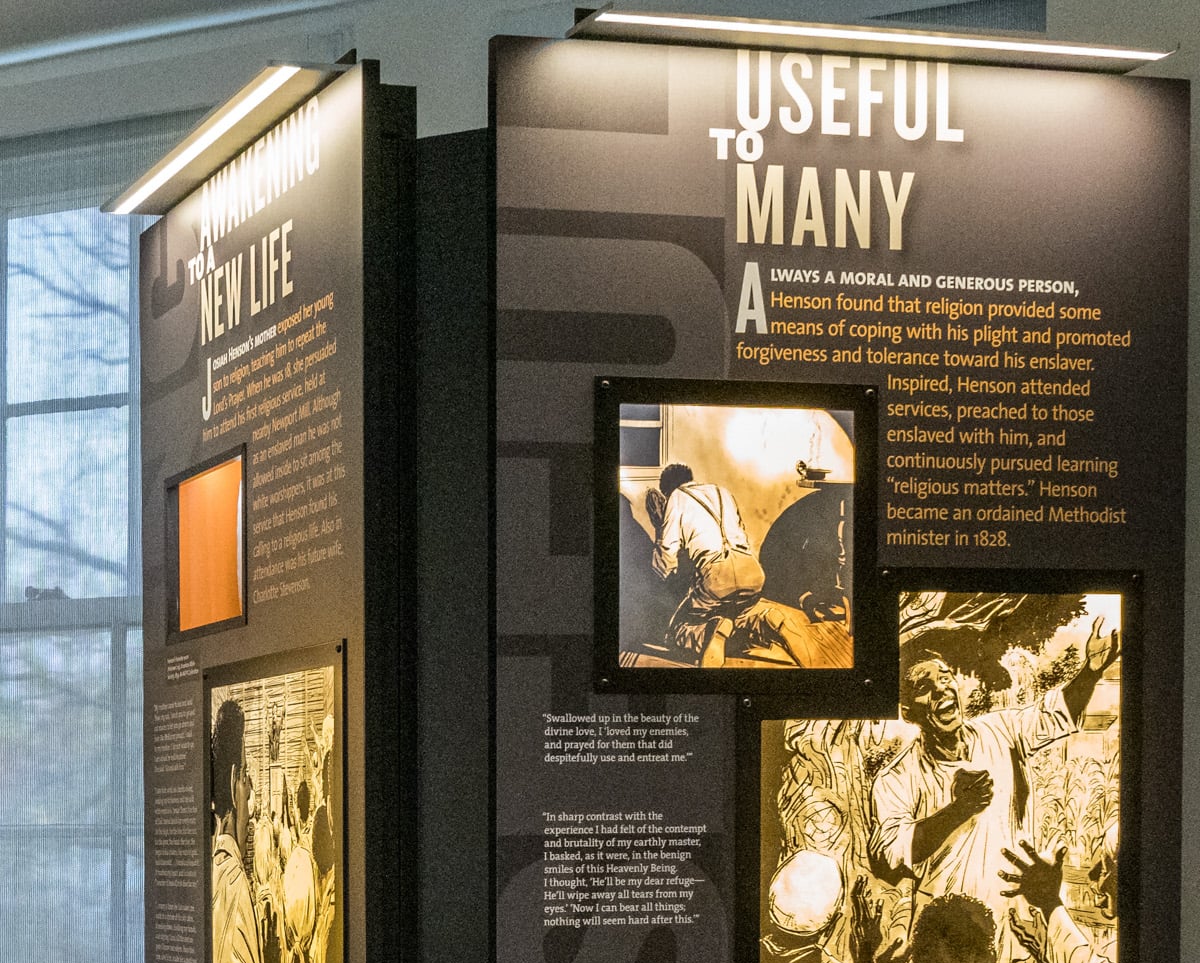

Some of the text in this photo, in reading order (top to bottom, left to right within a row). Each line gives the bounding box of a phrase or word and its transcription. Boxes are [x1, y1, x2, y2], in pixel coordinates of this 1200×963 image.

[736, 49, 964, 142] USEFUL
[709, 128, 763, 162] TO
[200, 95, 319, 252] AWAKENING
[736, 164, 915, 250] MANY
[188, 245, 216, 286] TO A
[201, 218, 294, 346] NEW LIFE
[824, 269, 836, 285] A
[840, 270, 894, 287] MORAL
[898, 272, 932, 289] AND
[935, 274, 1014, 292] GENEROUS
[1018, 277, 1080, 297] PERSON,
[770, 292, 1102, 322] Henson found that religion provided some
[770, 319, 1131, 350] means of coping with his plight and promoted
[736, 342, 1094, 371] forgiveness and tolerance toward his enslaver.
[887, 374, 1090, 397] Inspired, Henson attended
[886, 400, 1094, 424] services, preached to those
[886, 426, 1066, 449] enslaved with him, and
[886, 452, 1118, 479] continuously pursued learning
[1039, 480, 1097, 498] Henson
[886, 502, 1126, 524] became an ordained Methodist
[886, 528, 1010, 548] minister in 1828.
[544, 726, 574, 737] divine
[576, 726, 596, 738] love,
[598, 726, 602, 737] I
[632, 729, 647, 739] my
[649, 726, 688, 738] enemies,
[597, 716, 610, 726] up
[611, 713, 622, 723] in
[622, 713, 639, 723] the
[640, 713, 672, 726] beauty
[672, 713, 682, 723] of
[683, 713, 700, 723] the
[544, 753, 598, 766] despitefully
[600, 755, 616, 763] use
[617, 753, 635, 763] and
[636, 753, 669, 763] entreat
[557, 812, 584, 825] sharp
[585, 812, 622, 822] contrast
[624, 811, 646, 822] with
[647, 811, 663, 821] the
